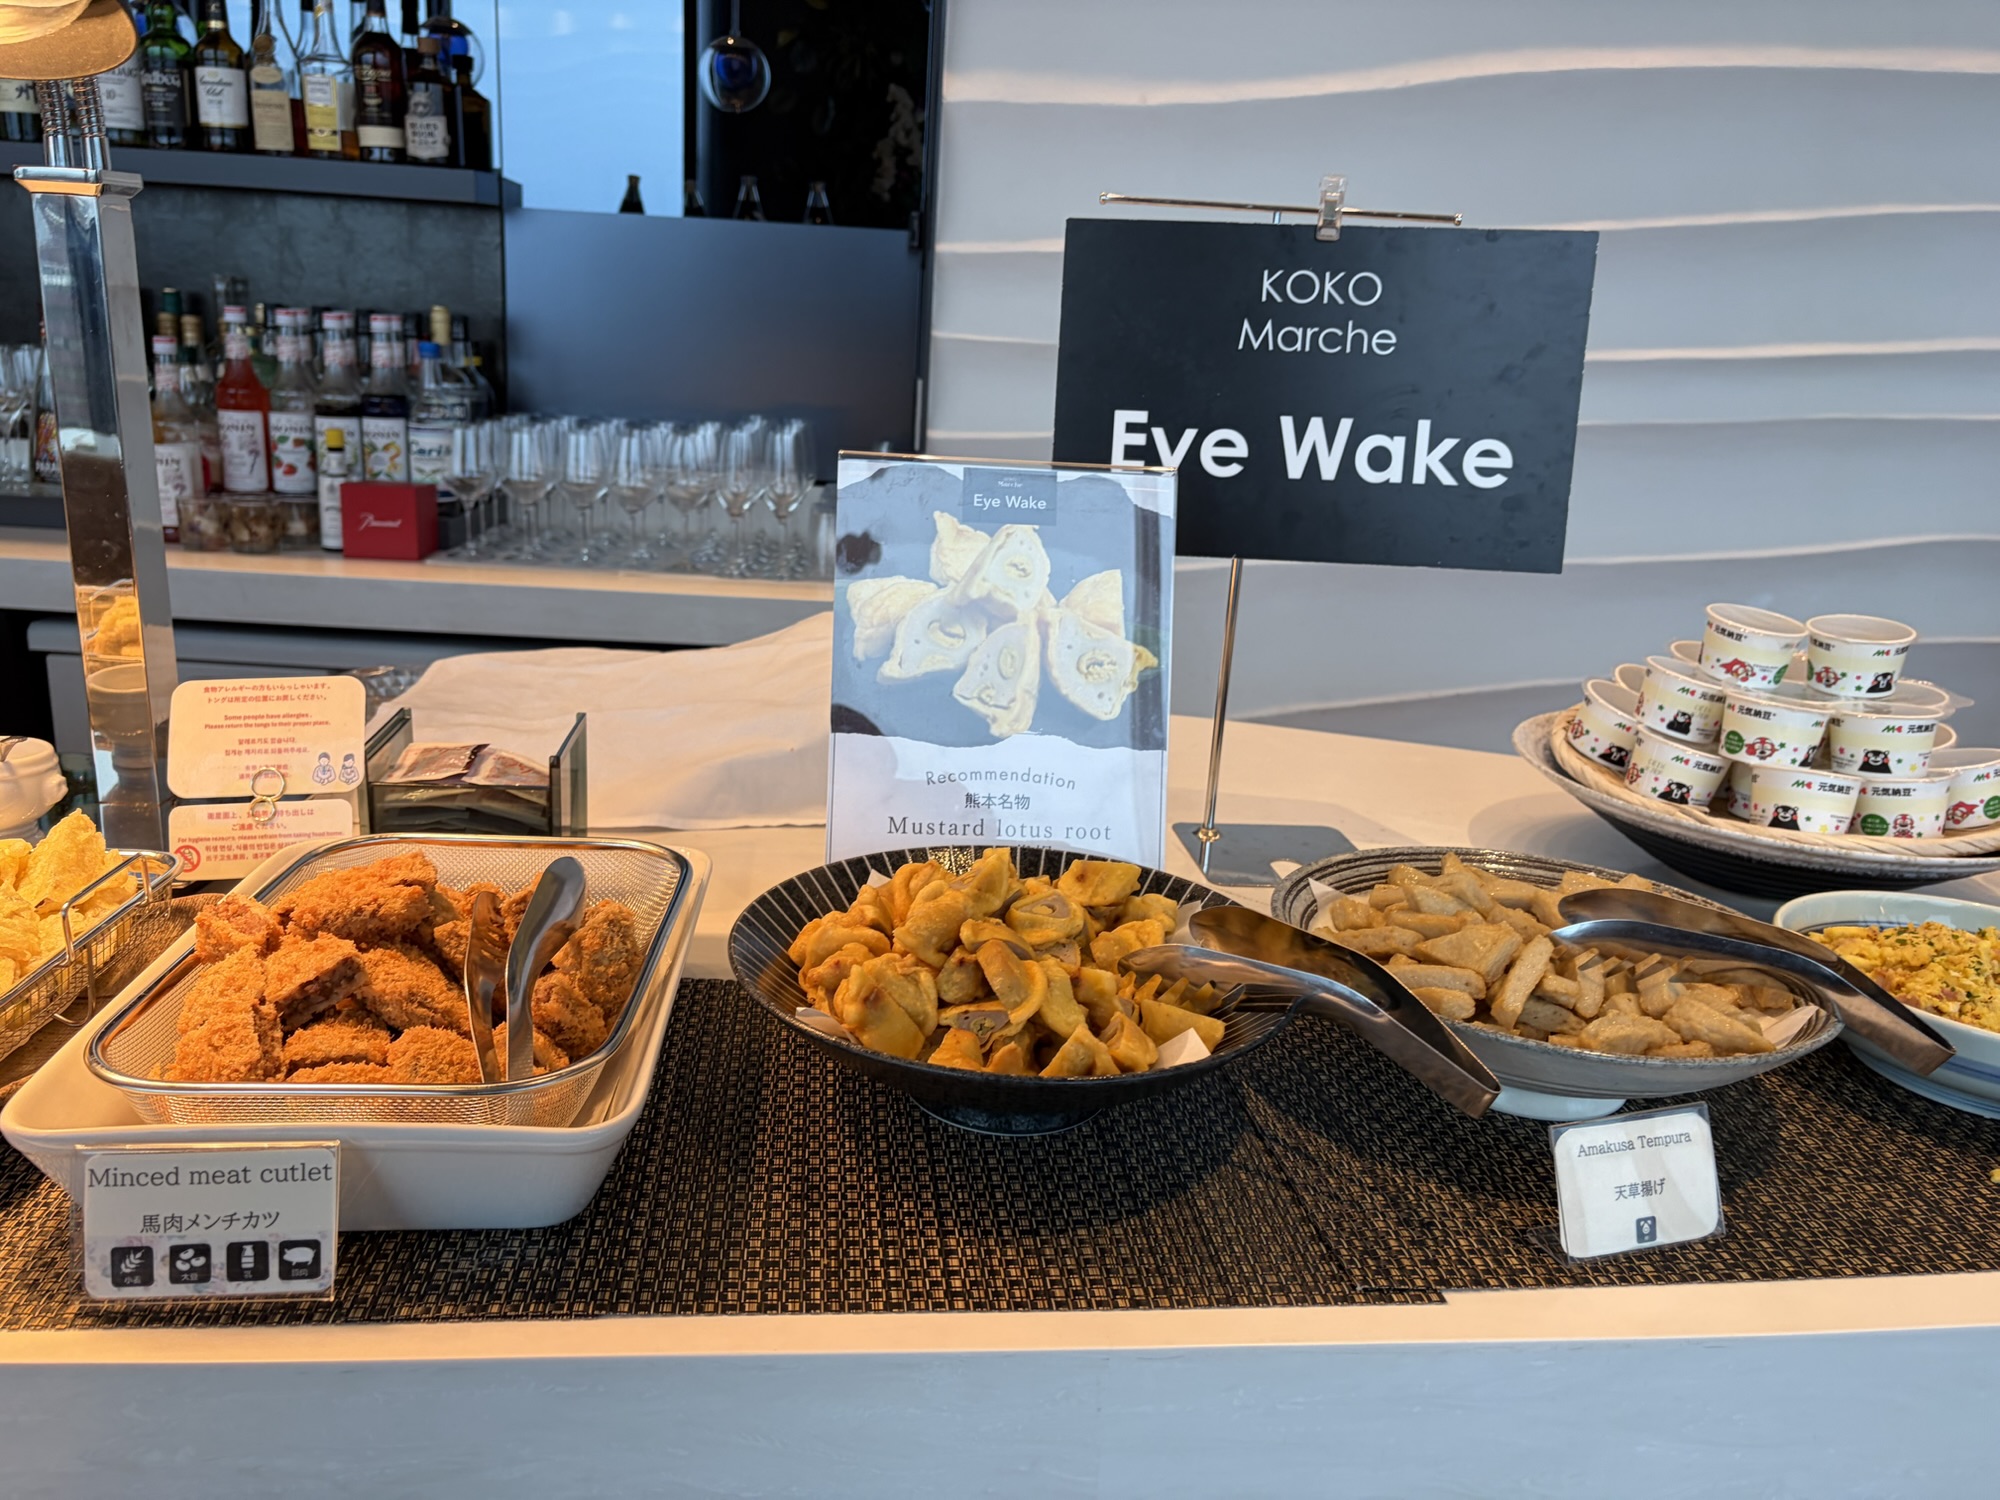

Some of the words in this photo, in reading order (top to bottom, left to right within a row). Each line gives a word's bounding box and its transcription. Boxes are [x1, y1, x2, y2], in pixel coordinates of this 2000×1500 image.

[1261, 269, 1383, 306] KOKO
[1237, 318, 1398, 356] Marche
[1279, 415, 1515, 489] Wake
[973, 493, 1001, 511] Eye
[1005, 495, 1047, 510] Wake
[925, 767, 1076, 790] Recommendation
[1817, 782, 1852, 795] 元気納豆
[964, 792, 1031, 811] 熊本名物
[1871, 786, 1912, 797] 元気納豆
[887, 816, 985, 837] Mustard
[997, 819, 1053, 839] lotus
[1065, 824, 1112, 840] root
[1577, 1140, 1636, 1158] Amakusa
[1637, 1131, 1692, 1149] Tempura
[88, 1166, 181, 1188] Minced
[189, 1166, 253, 1186] meat
[260, 1163, 333, 1184] cutlet
[1614, 1178, 1666, 1201] 天草揚げ
[140, 1210, 281, 1235] 馬肉メンチカツ
